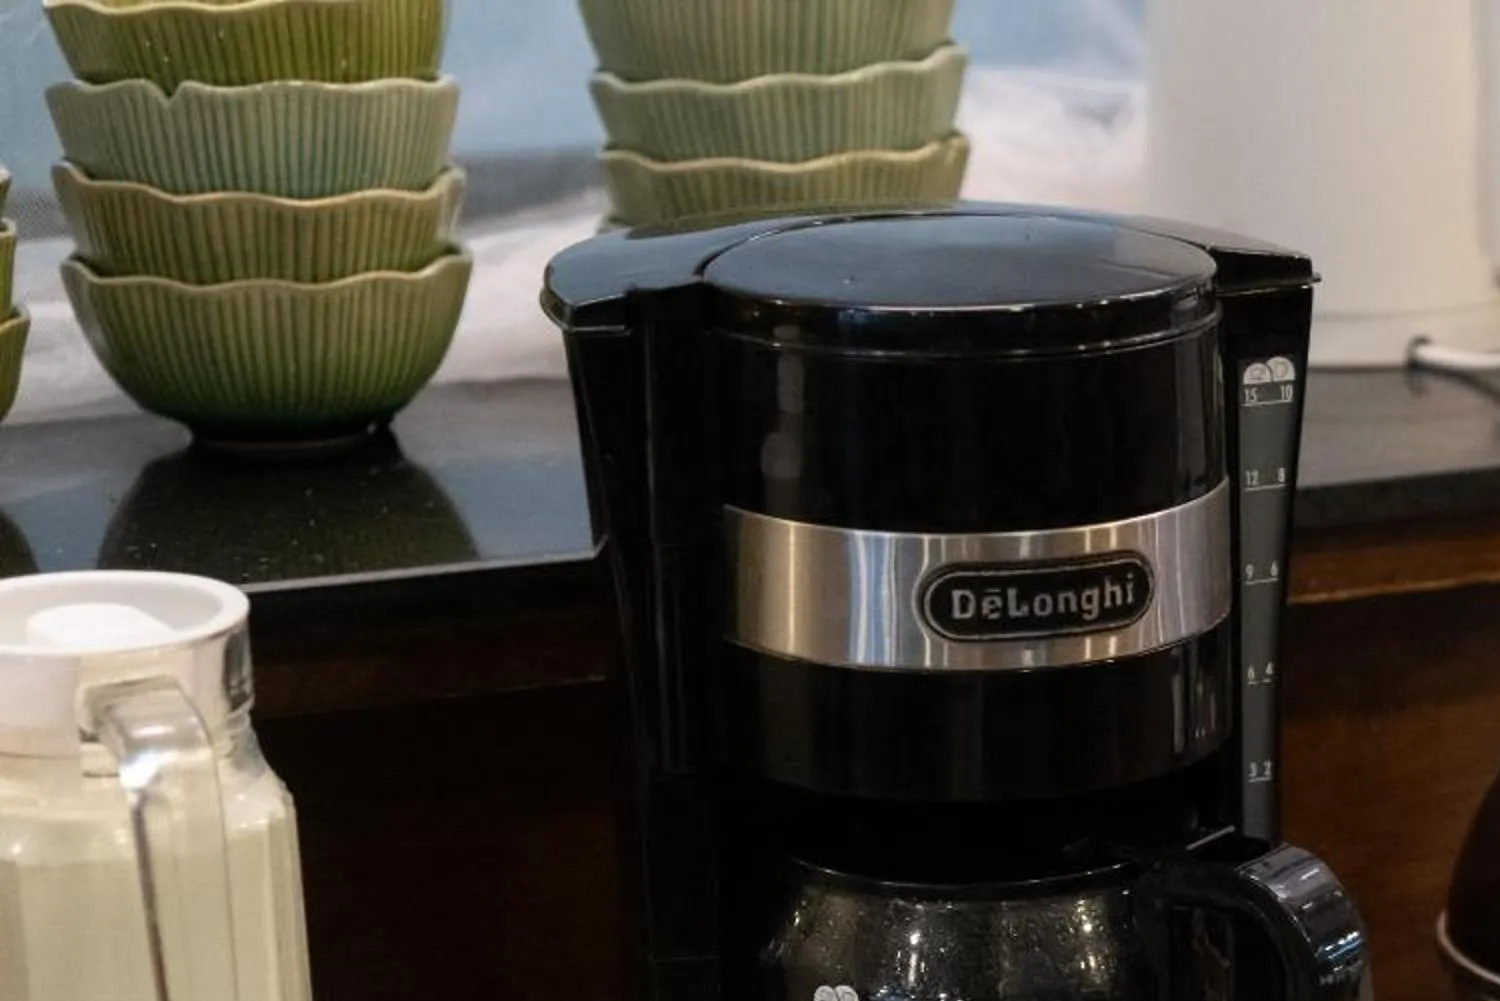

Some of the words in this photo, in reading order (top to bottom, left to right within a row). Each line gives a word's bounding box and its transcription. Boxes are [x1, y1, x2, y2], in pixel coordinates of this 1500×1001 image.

[1244, 387, 1258, 403] 15
[1280, 383, 1293, 401] 10
[1245, 470, 1259, 486] 12
